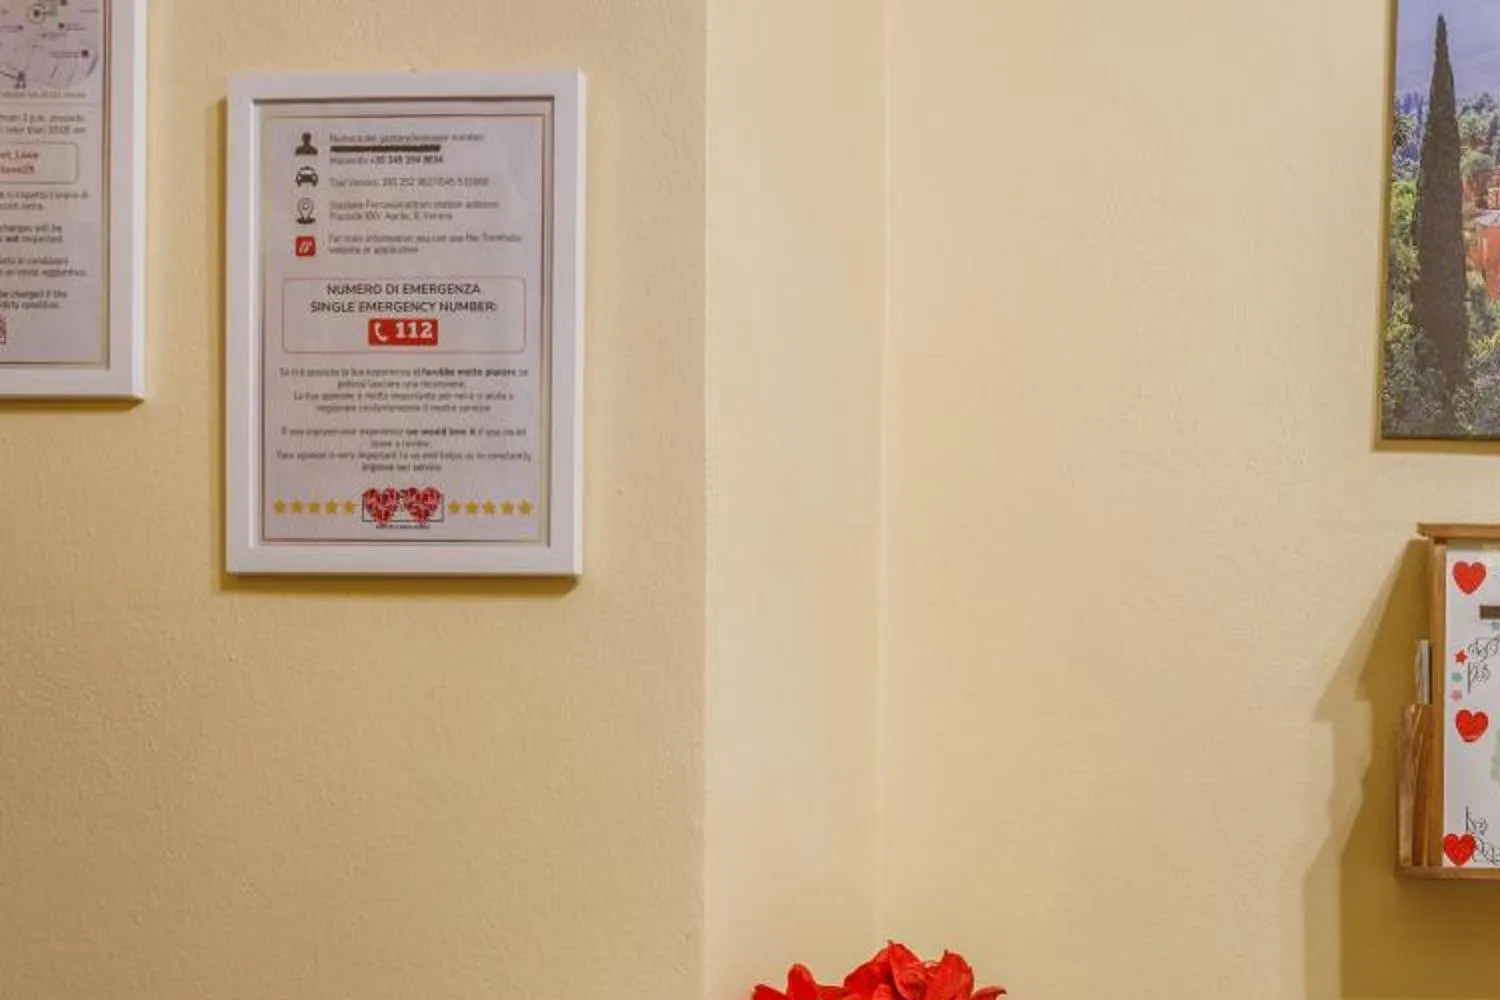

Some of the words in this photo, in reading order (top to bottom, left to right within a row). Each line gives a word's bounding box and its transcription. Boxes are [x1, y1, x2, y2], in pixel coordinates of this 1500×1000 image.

[326, 283, 382, 295] NUMERO
[386, 283, 399, 295] DI
[402, 283, 481, 295] EMERGENZA
[310, 301, 355, 313] SINGLE
[358, 301, 436, 313] EMERGENCY
[394, 321, 434, 340] 112
